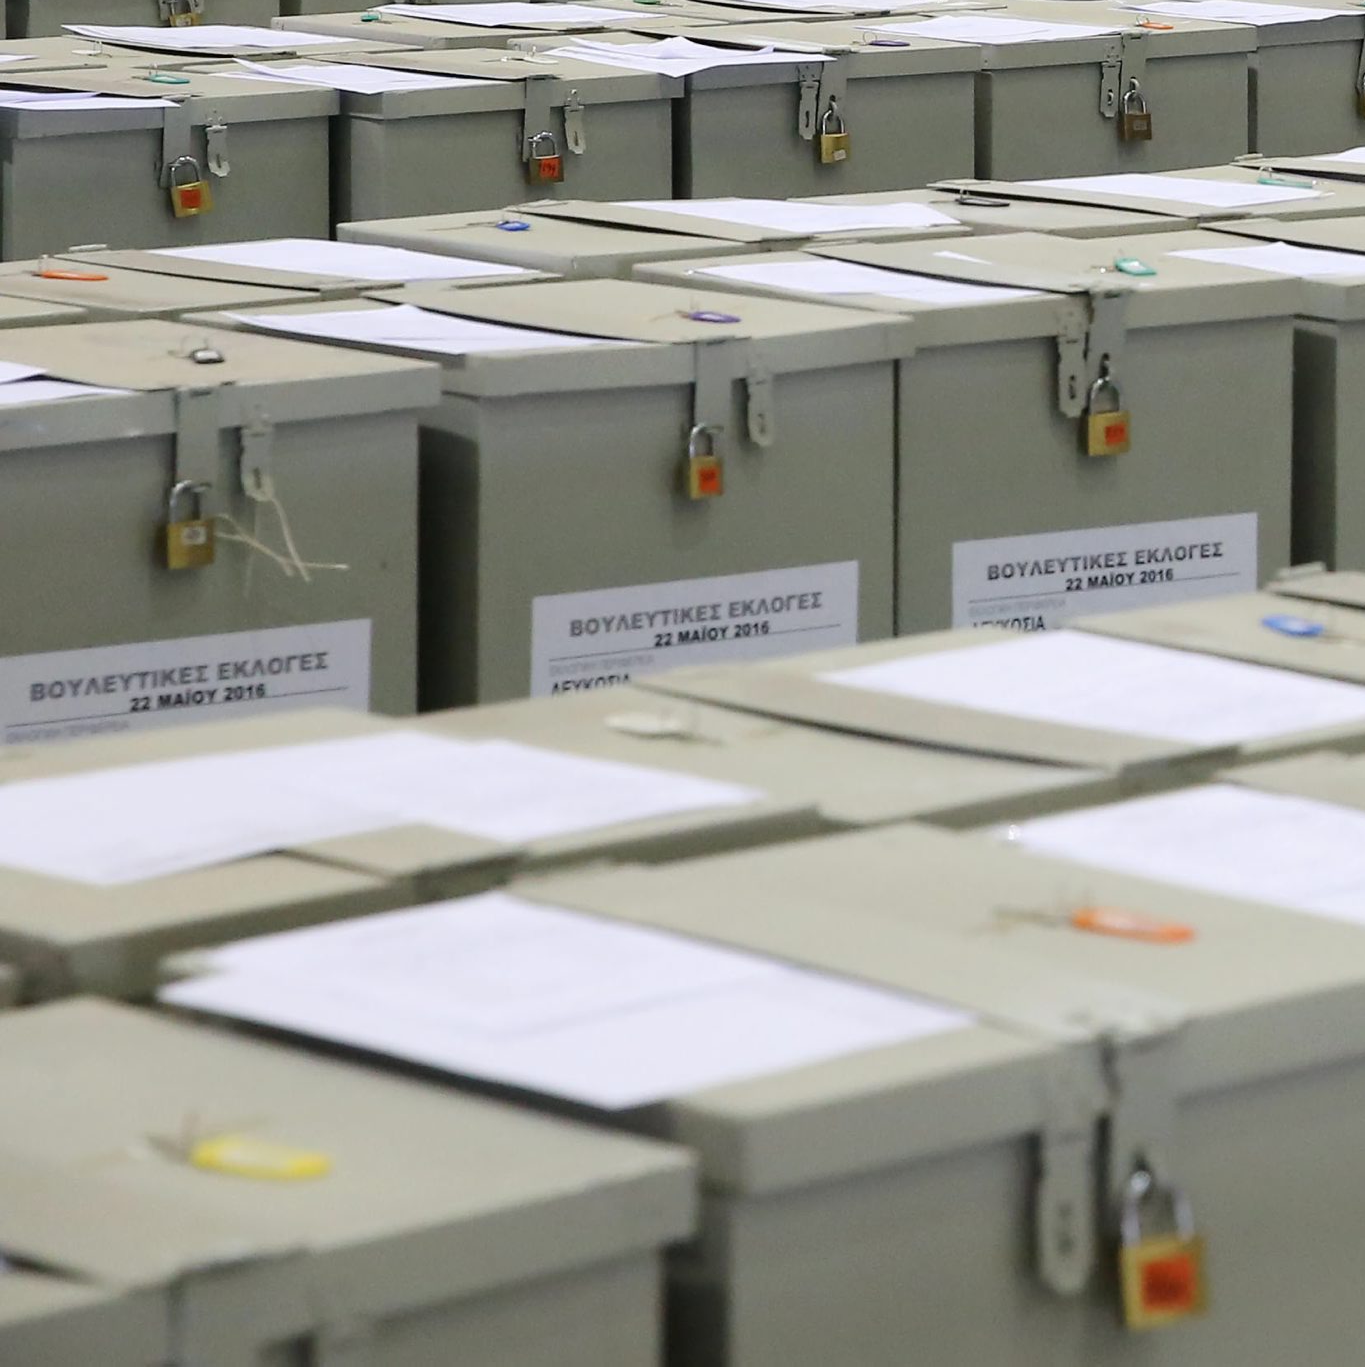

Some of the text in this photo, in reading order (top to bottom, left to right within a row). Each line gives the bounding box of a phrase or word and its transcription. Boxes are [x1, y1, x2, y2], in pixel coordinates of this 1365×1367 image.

[987, 542, 1224, 581] ΒΟΥΛΕΥΤΙΚΕΣ ΕΚΛΟΓΕΣ
[1066, 577, 1082, 591] 22
[1141, 568, 1173, 583] 2016
[570, 592, 822, 636] ΒΟΥΛΕΥΤΙΚΕΣ ΕΚΛΟΓΕΣ
[654, 633, 672, 647] 22
[735, 621, 770, 637] 2016
[30, 652, 328, 702] ΒΟΥΛΕΥΤΙΚΕΣ ΕΚΛΟΓΕΣ
[130, 697, 150, 712] 22
[225, 684, 265, 702] 2016
